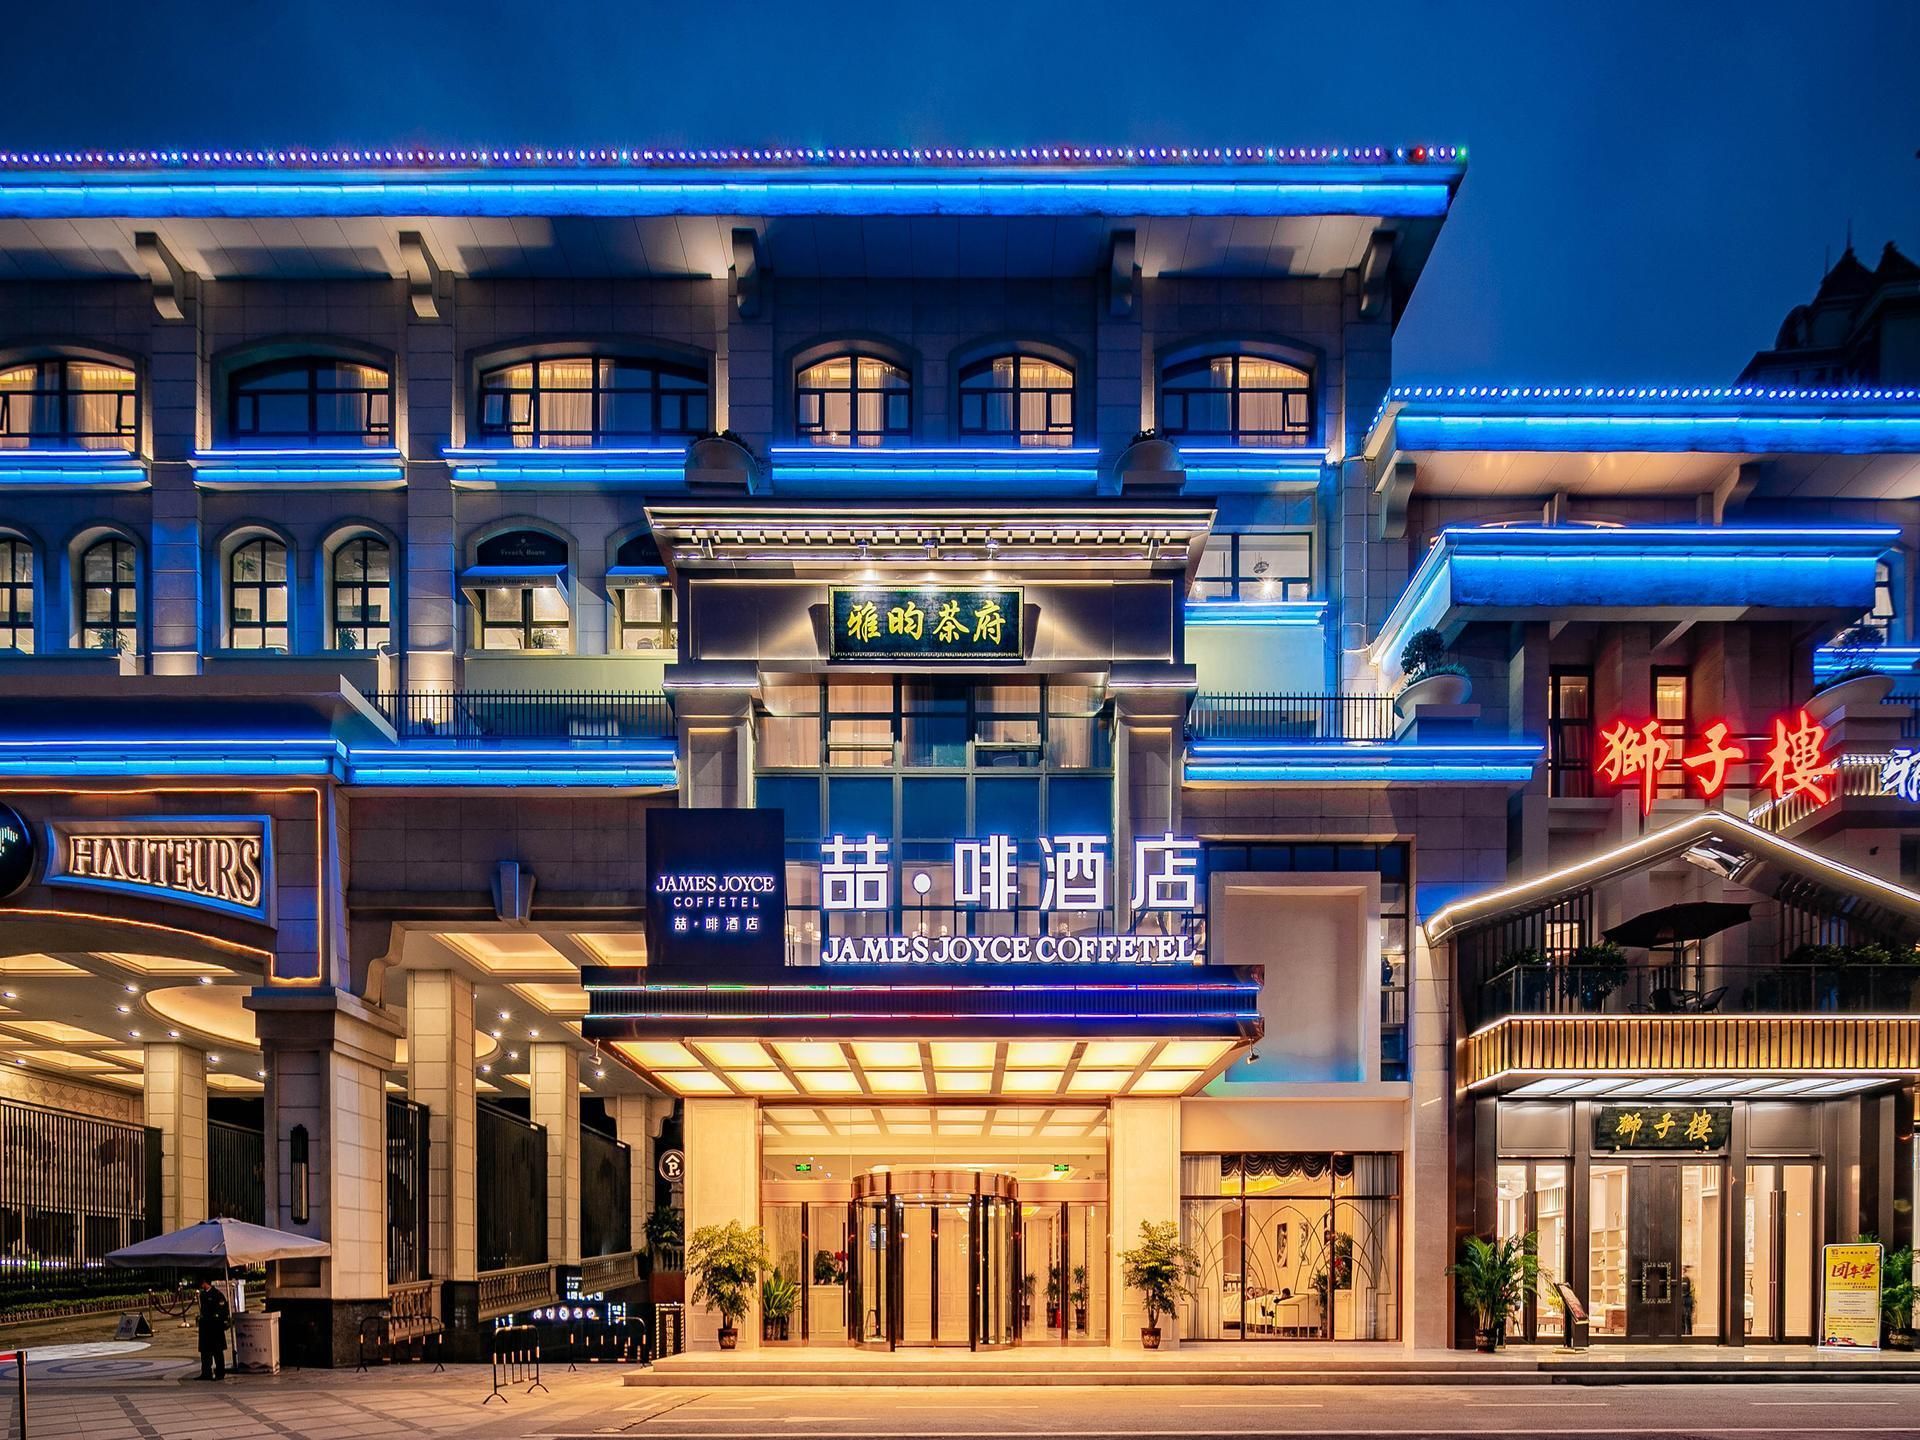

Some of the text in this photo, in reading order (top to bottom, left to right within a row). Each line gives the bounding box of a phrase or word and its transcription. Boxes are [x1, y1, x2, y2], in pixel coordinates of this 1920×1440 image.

[480, 576, 538, 584] French Restaurant
[847, 600, 1006, 645] 雅昀茶府
[1597, 711, 1838, 816] 獅子樓
[70, 837, 261, 907] HAUTEURS
[656, 876, 775, 892] JAMES JOYCE
[673, 897, 759, 908] COFFETEL
[822, 936, 1198, 964] JAMES JOYCE COFFETEL
[1615, 1108, 1713, 1146] 獅子樓
[667, 1162, 679, 1176] P
